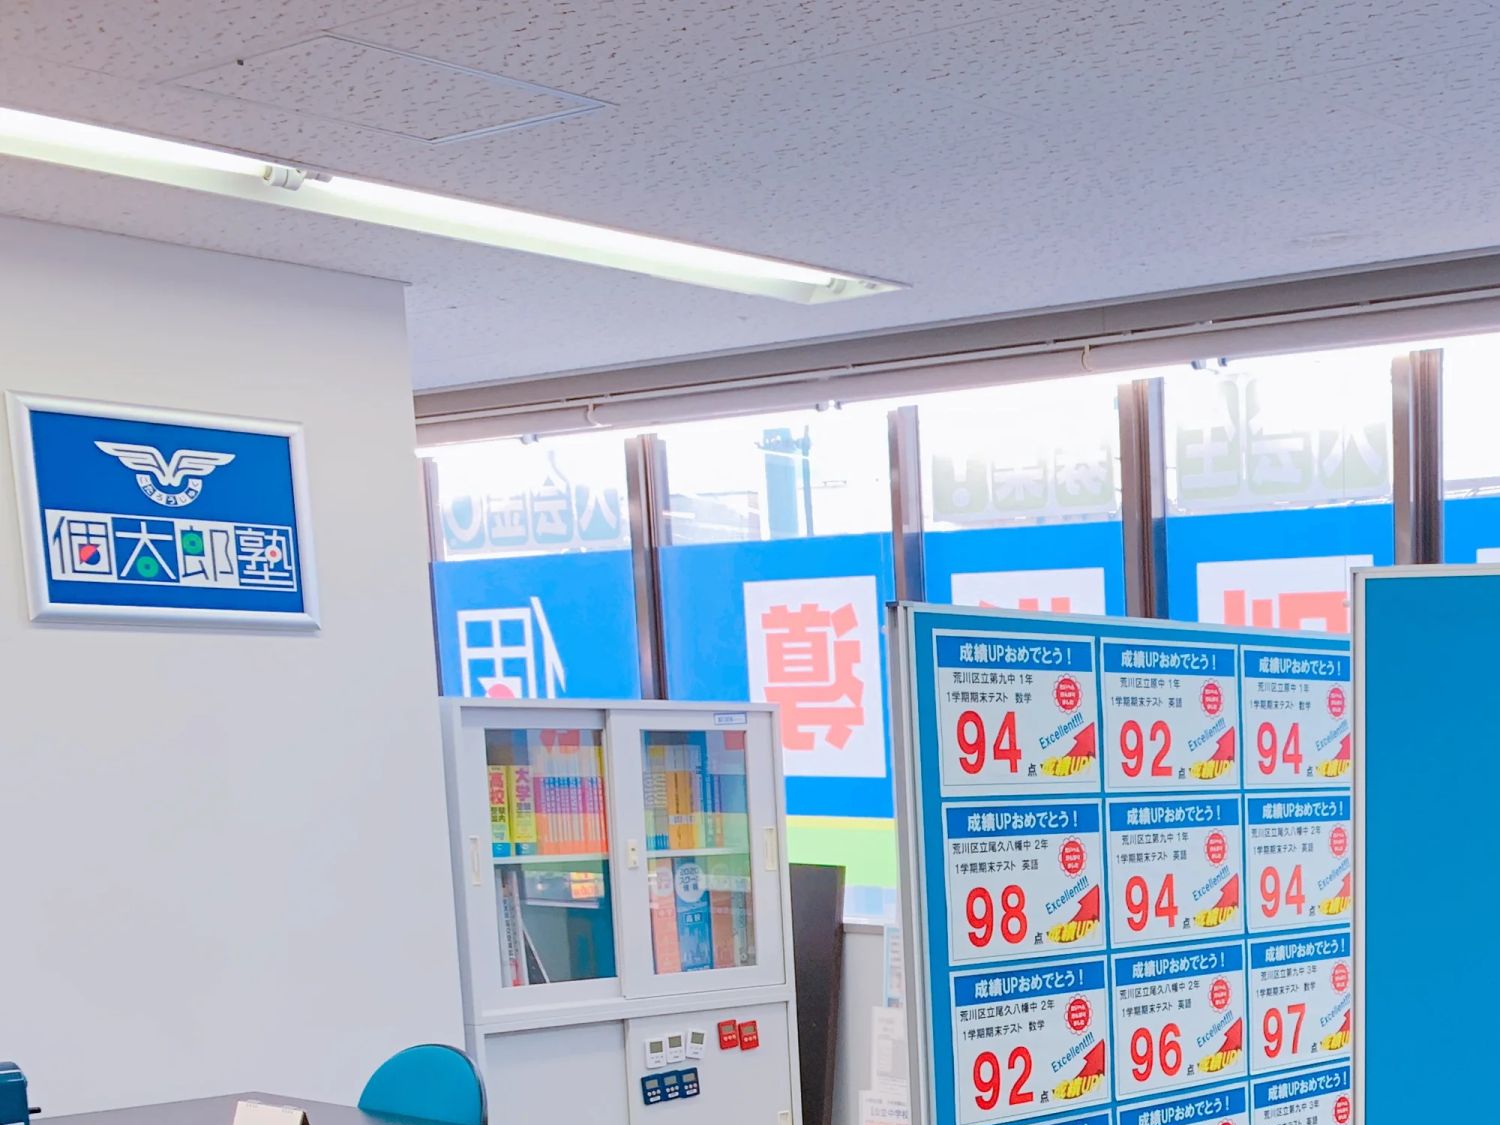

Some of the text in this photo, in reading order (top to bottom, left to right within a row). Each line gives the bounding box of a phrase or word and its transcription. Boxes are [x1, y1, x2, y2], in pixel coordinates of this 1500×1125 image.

[48, 511, 297, 591] 個太郎塾
[956, 709, 1023, 775] 94
[1119, 719, 1173, 777] 92
[1257, 721, 1303, 775] 94
[965, 884, 1028, 948] 98
[1124, 873, 1179, 932] 94
[1260, 865, 1305, 918] 94
[1129, 1022, 1183, 1083] 96
[1262, 1003, 1306, 1059] 97
[972, 1045, 1034, 1111] 92
